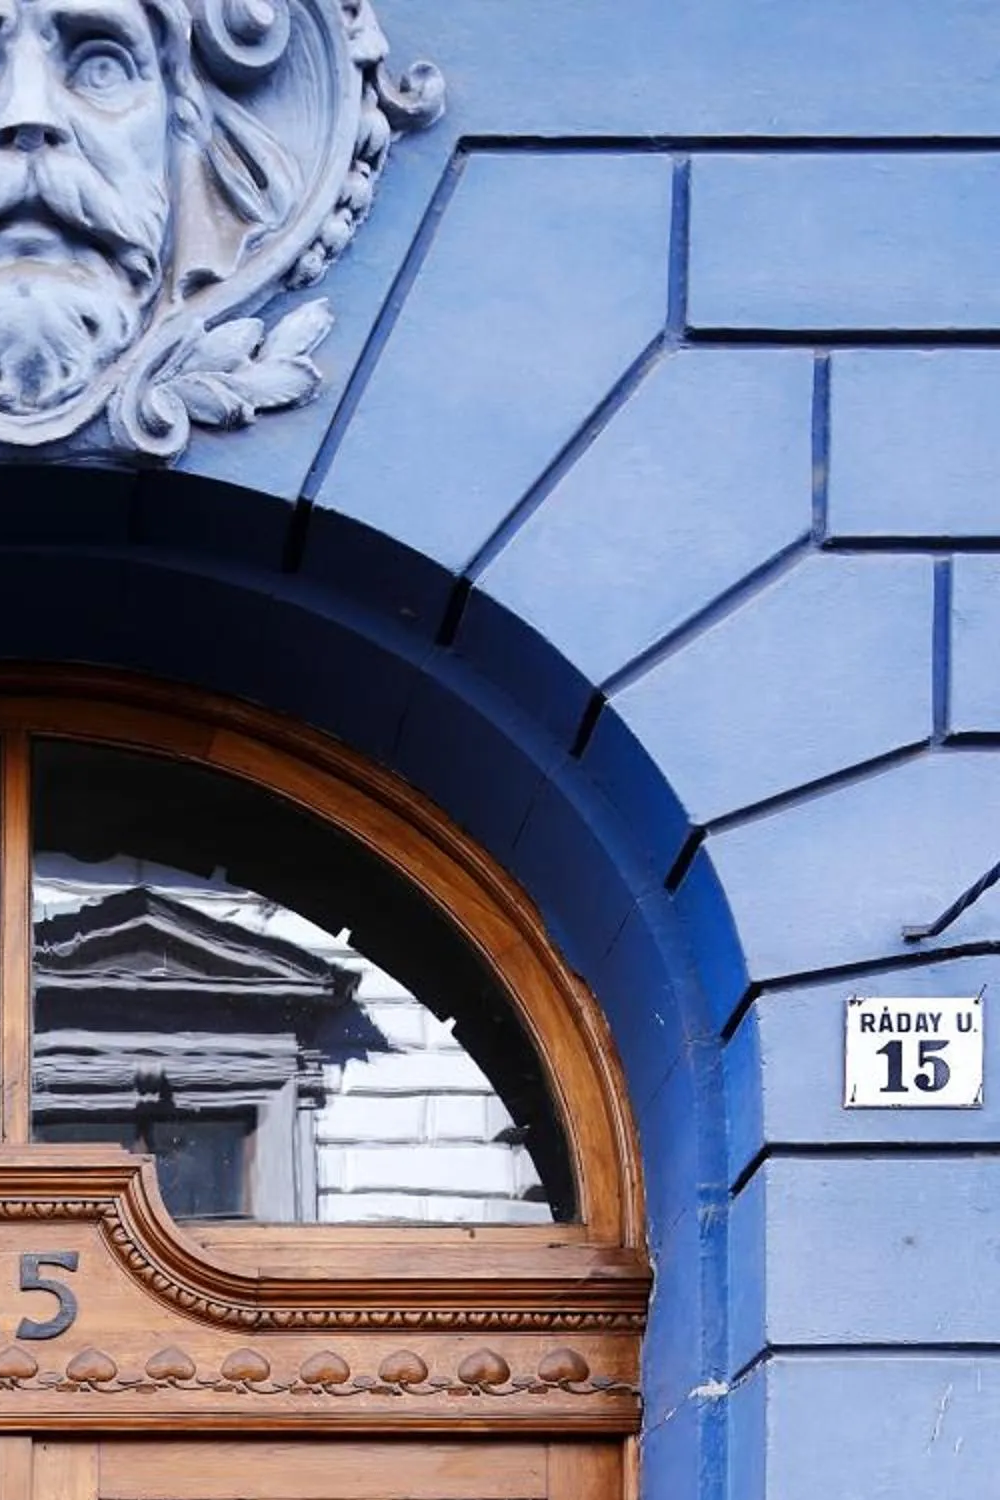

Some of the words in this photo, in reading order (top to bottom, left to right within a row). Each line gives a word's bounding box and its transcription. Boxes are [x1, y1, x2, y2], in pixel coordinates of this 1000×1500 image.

[860, 1006, 942, 1033] RÁDAY
[956, 1012, 978, 1033] U.
[876, 1040, 950, 1092] 15
